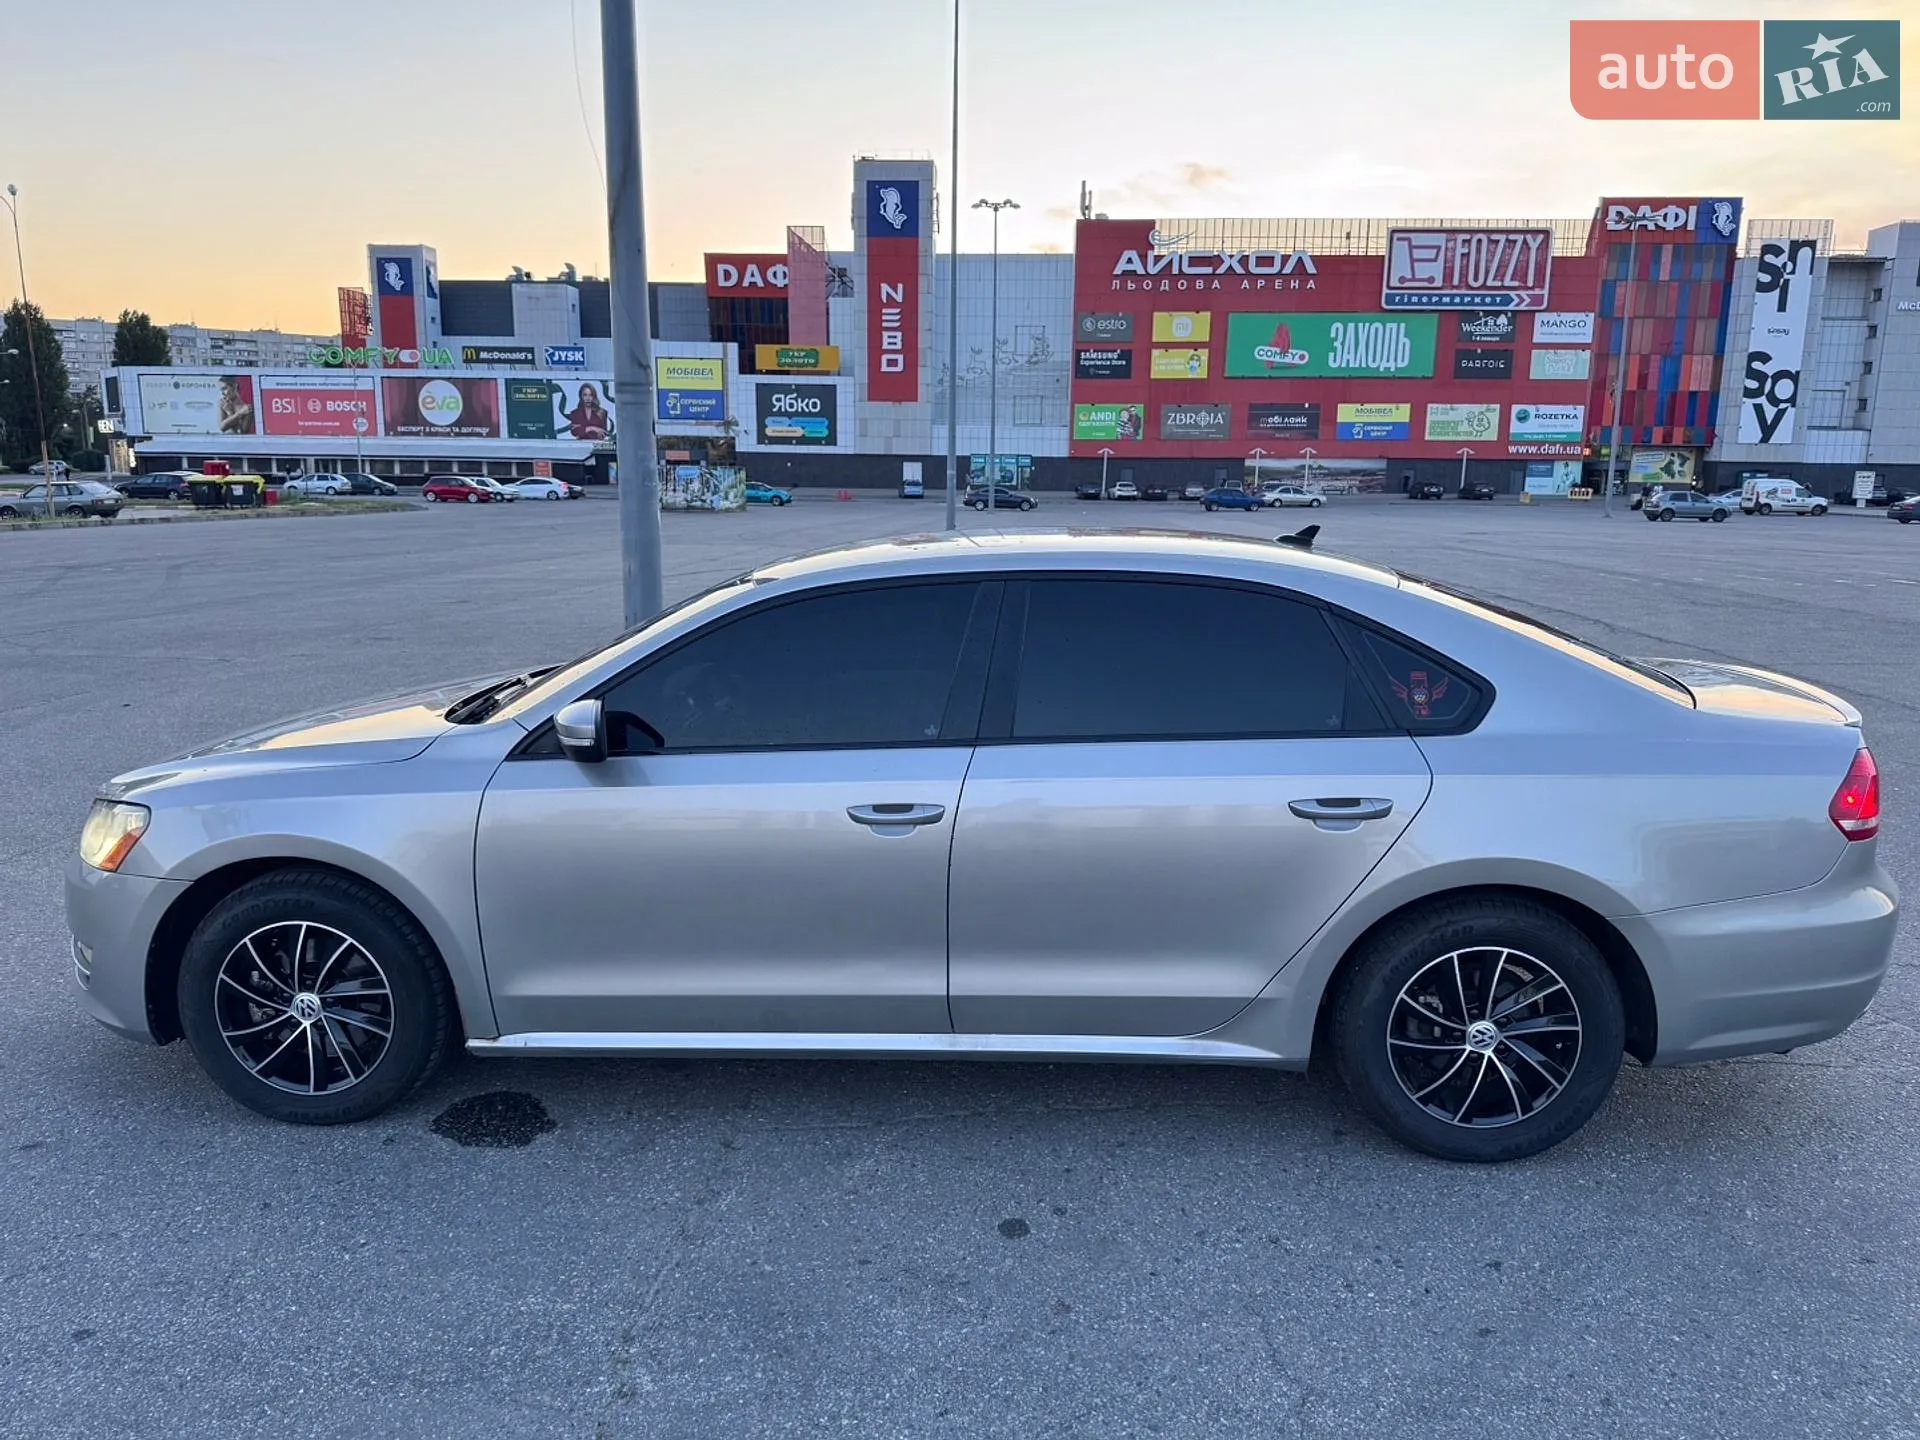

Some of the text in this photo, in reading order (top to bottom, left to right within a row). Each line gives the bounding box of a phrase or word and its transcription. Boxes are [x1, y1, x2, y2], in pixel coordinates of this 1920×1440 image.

[1452, 234, 1544, 288] FOZZY
[1112, 280, 1317, 292] ЛЬОДОВА АРЕНА
[1097, 319, 1127, 330] estro
[1461, 322, 1513, 333] Weekender
[1540, 320, 1586, 328] MANGO
[1328, 321, 1412, 372] ЗАХОДЬ
[308, 346, 400, 365] COMFY
[480, 350, 532, 360] McDonald's
[552, 350, 584, 362] JYSK
[1257, 348, 1298, 361] COMFY
[326, 400, 367, 412] BOSCH
[772, 393, 820, 412] Ябко
[1090, 412, 1116, 421] ANDI
[1508, 443, 1581, 455] www.dafi.ua
